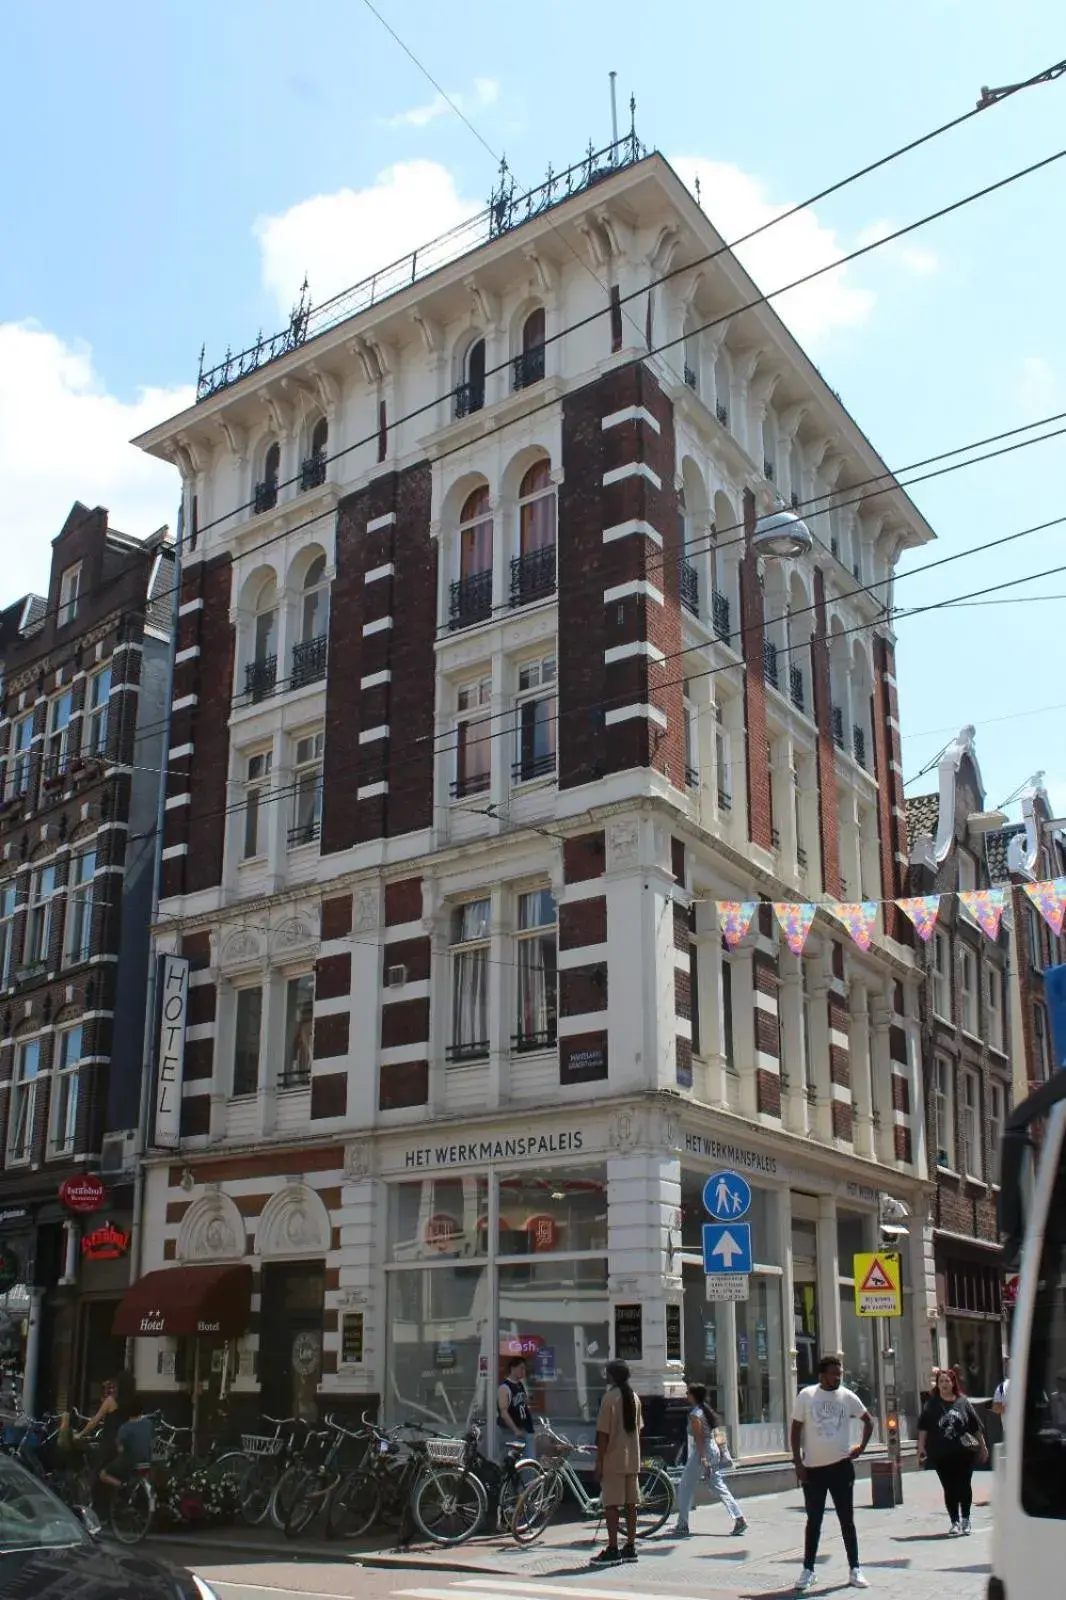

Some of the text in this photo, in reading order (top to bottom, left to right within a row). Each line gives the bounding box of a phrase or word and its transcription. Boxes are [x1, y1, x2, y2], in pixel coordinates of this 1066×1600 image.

[160, 964, 185, 1112] HOTEL
[405, 1131, 583, 1167] HET WERKMANSPALEIS
[685, 1133, 777, 1173] HET WERKMANSPALEIS
[140, 1319, 165, 1331] Hotel
[198, 1321, 220, 1331] Hotel
